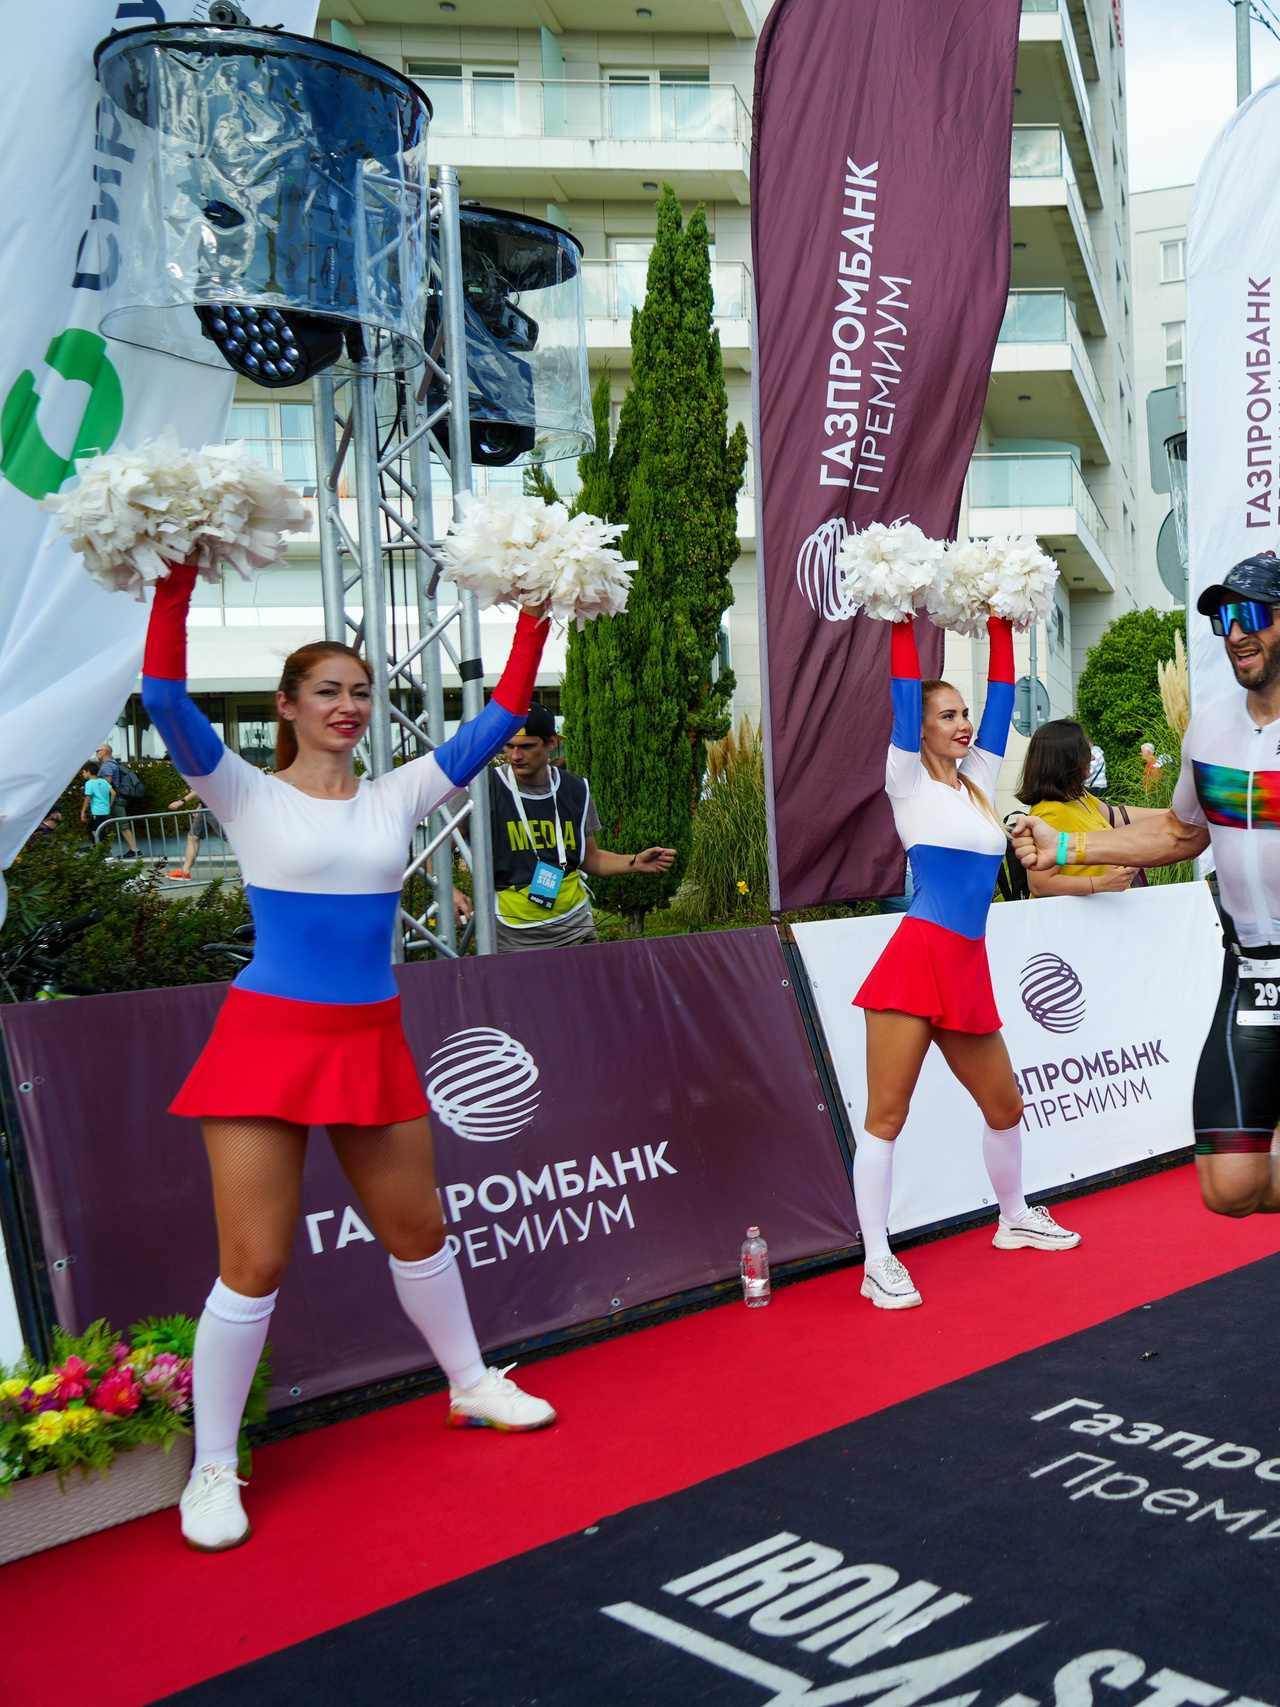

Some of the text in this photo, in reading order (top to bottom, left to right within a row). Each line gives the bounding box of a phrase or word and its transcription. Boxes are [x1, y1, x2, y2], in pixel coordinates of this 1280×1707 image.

[819, 156, 879, 487] ГАЗПРОМБАНК
[853, 274, 912, 493] ПРЕМИУМ
[1246, 277, 1271, 529] ГАЗПРОМБАНК
[506, 819, 577, 852] MEDA
[537, 875, 556, 890] STAR
[1023, 1076, 1152, 1131] ПРЕМИУМ
[661, 1531, 973, 1668] IRON
